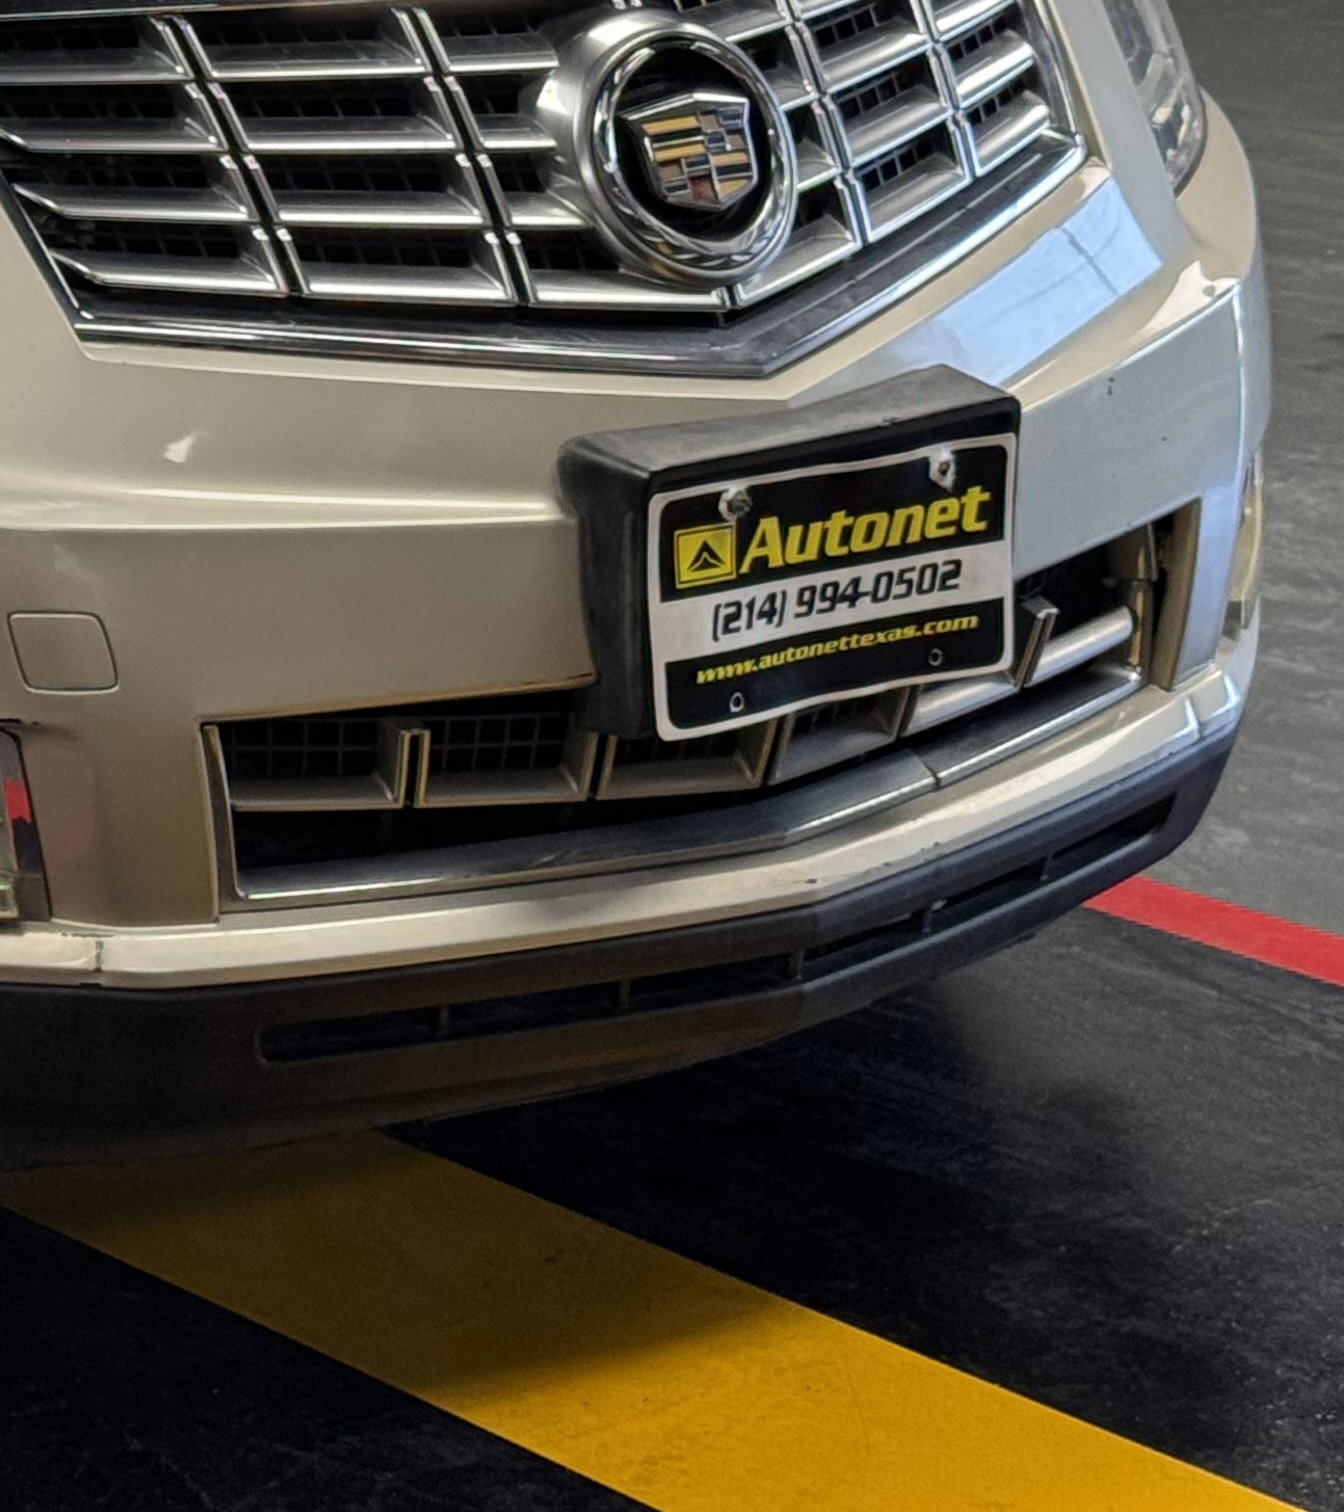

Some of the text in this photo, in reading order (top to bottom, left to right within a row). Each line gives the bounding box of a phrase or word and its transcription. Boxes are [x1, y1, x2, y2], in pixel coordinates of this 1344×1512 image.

[739, 485, 992, 575] Autonet
[712, 558, 963, 643] (214) 994-0502
[695, 615, 981, 685] www.autonettexas.com
